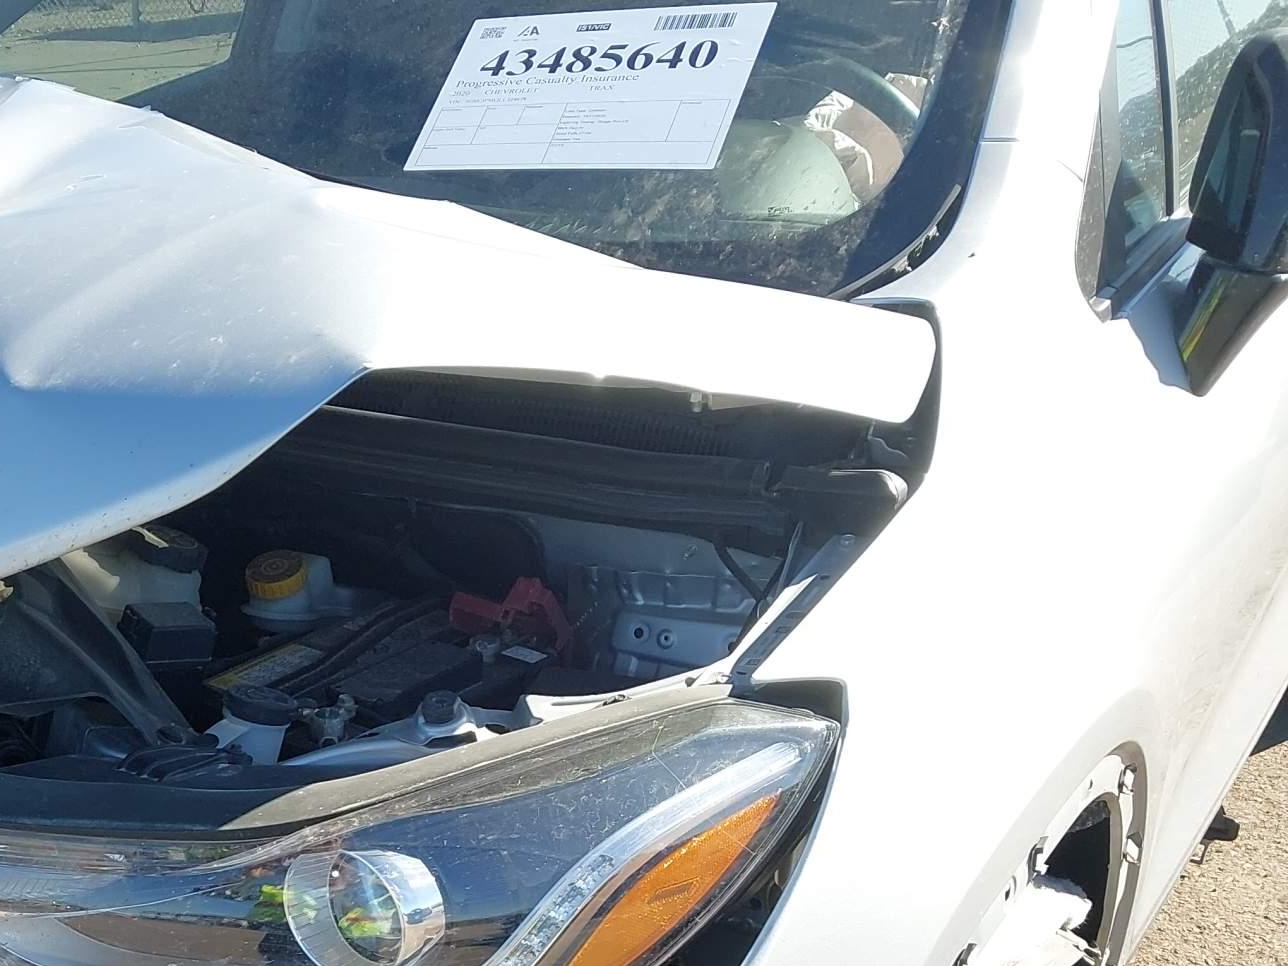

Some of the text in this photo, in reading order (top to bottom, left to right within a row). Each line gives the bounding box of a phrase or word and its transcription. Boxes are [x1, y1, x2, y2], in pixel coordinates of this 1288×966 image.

[480, 39, 719, 77] 43485640
[455, 73, 640, 90] Progressive Casualty Insurance
[484, 87, 540, 96] CHEVROLET
